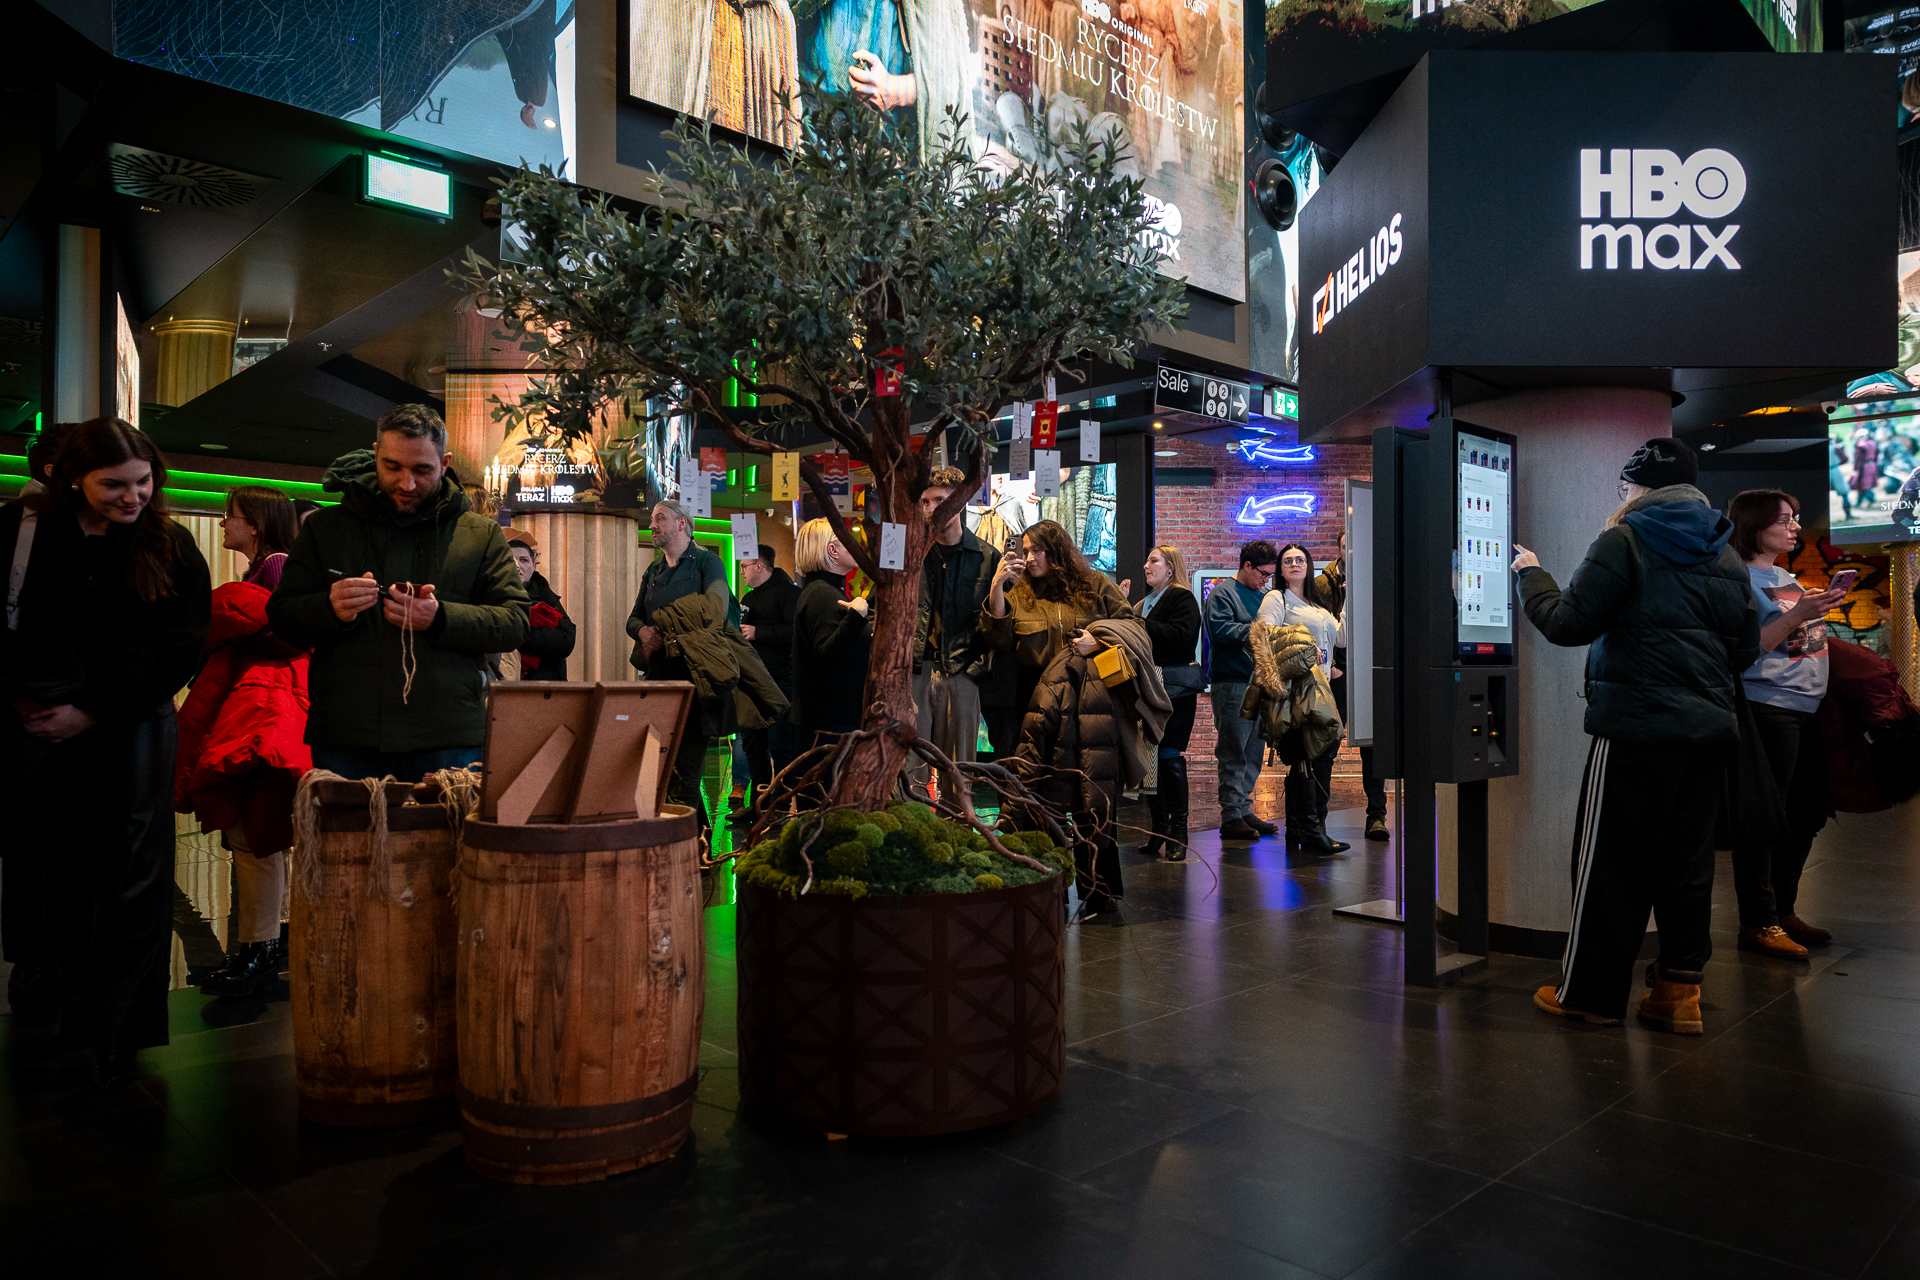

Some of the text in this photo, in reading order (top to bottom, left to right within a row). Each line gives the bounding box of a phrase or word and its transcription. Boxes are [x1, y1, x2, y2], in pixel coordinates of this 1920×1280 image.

[1111, 17, 1154, 49] ORIGINAL
[1077, 15, 1160, 84] RYCERZ
[1003, 14, 1218, 141] SIEDMIU KRÓLESTW
[1580, 148, 1747, 219] HBO
[1580, 223, 1742, 270] max
[1336, 212, 1403, 314] HELIOS
[1158, 369, 1189, 393] Sale
[524, 454, 567, 464] RYCERZ
[540, 463, 599, 475] KRÓLESTW
[515, 492, 545, 502] TERAZ
[550, 495, 574, 504] max
[551, 485, 575, 496] HBO
